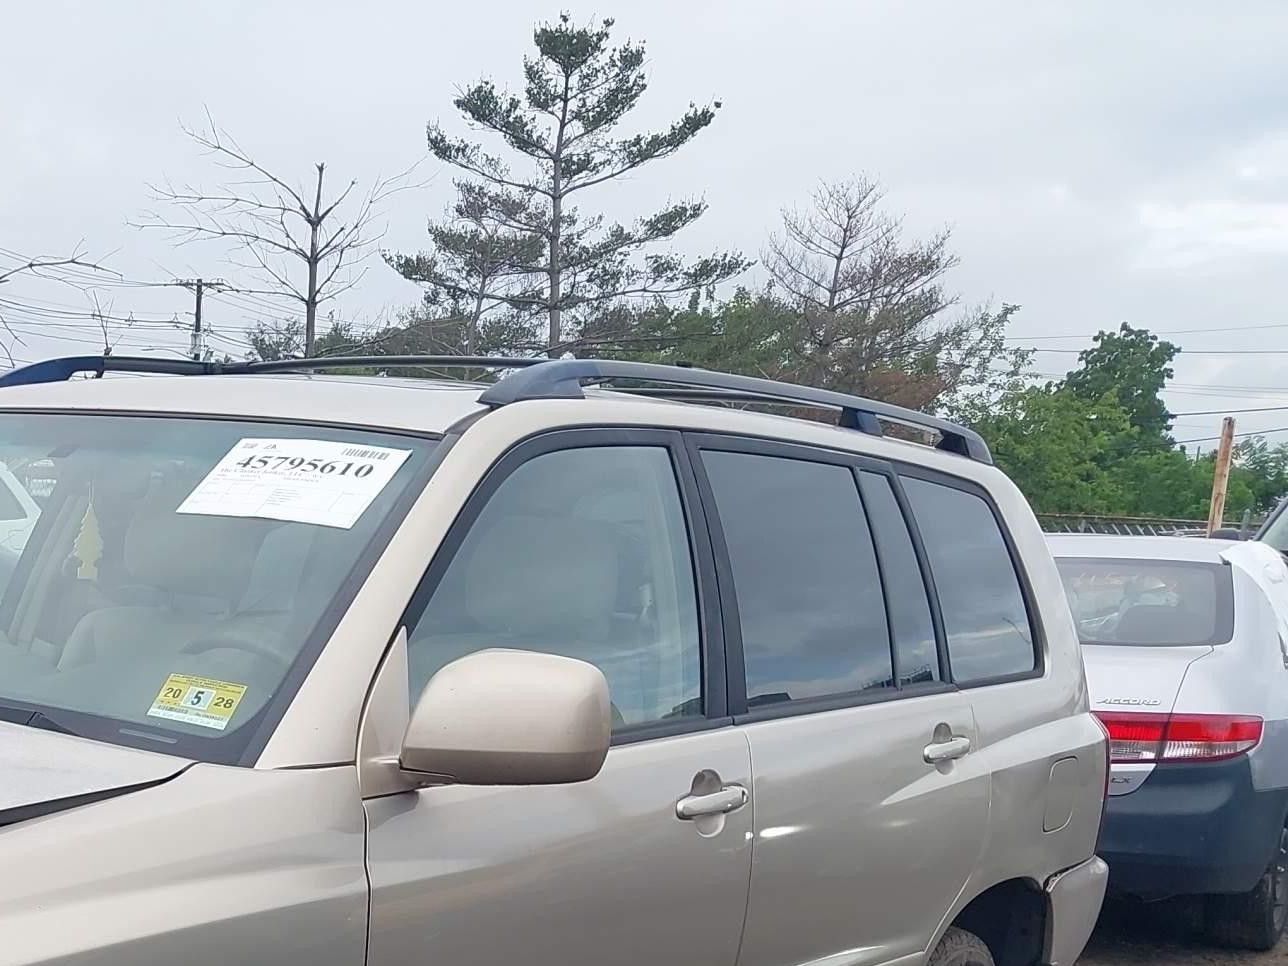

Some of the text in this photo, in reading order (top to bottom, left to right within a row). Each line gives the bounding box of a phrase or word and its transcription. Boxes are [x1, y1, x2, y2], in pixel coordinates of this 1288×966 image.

[236, 454, 374, 478] 45795610
[163, 687, 183, 699] 20
[191, 690, 205, 705] 5
[213, 696, 234, 709] 28
[1096, 697, 1161, 706] ACCORD
